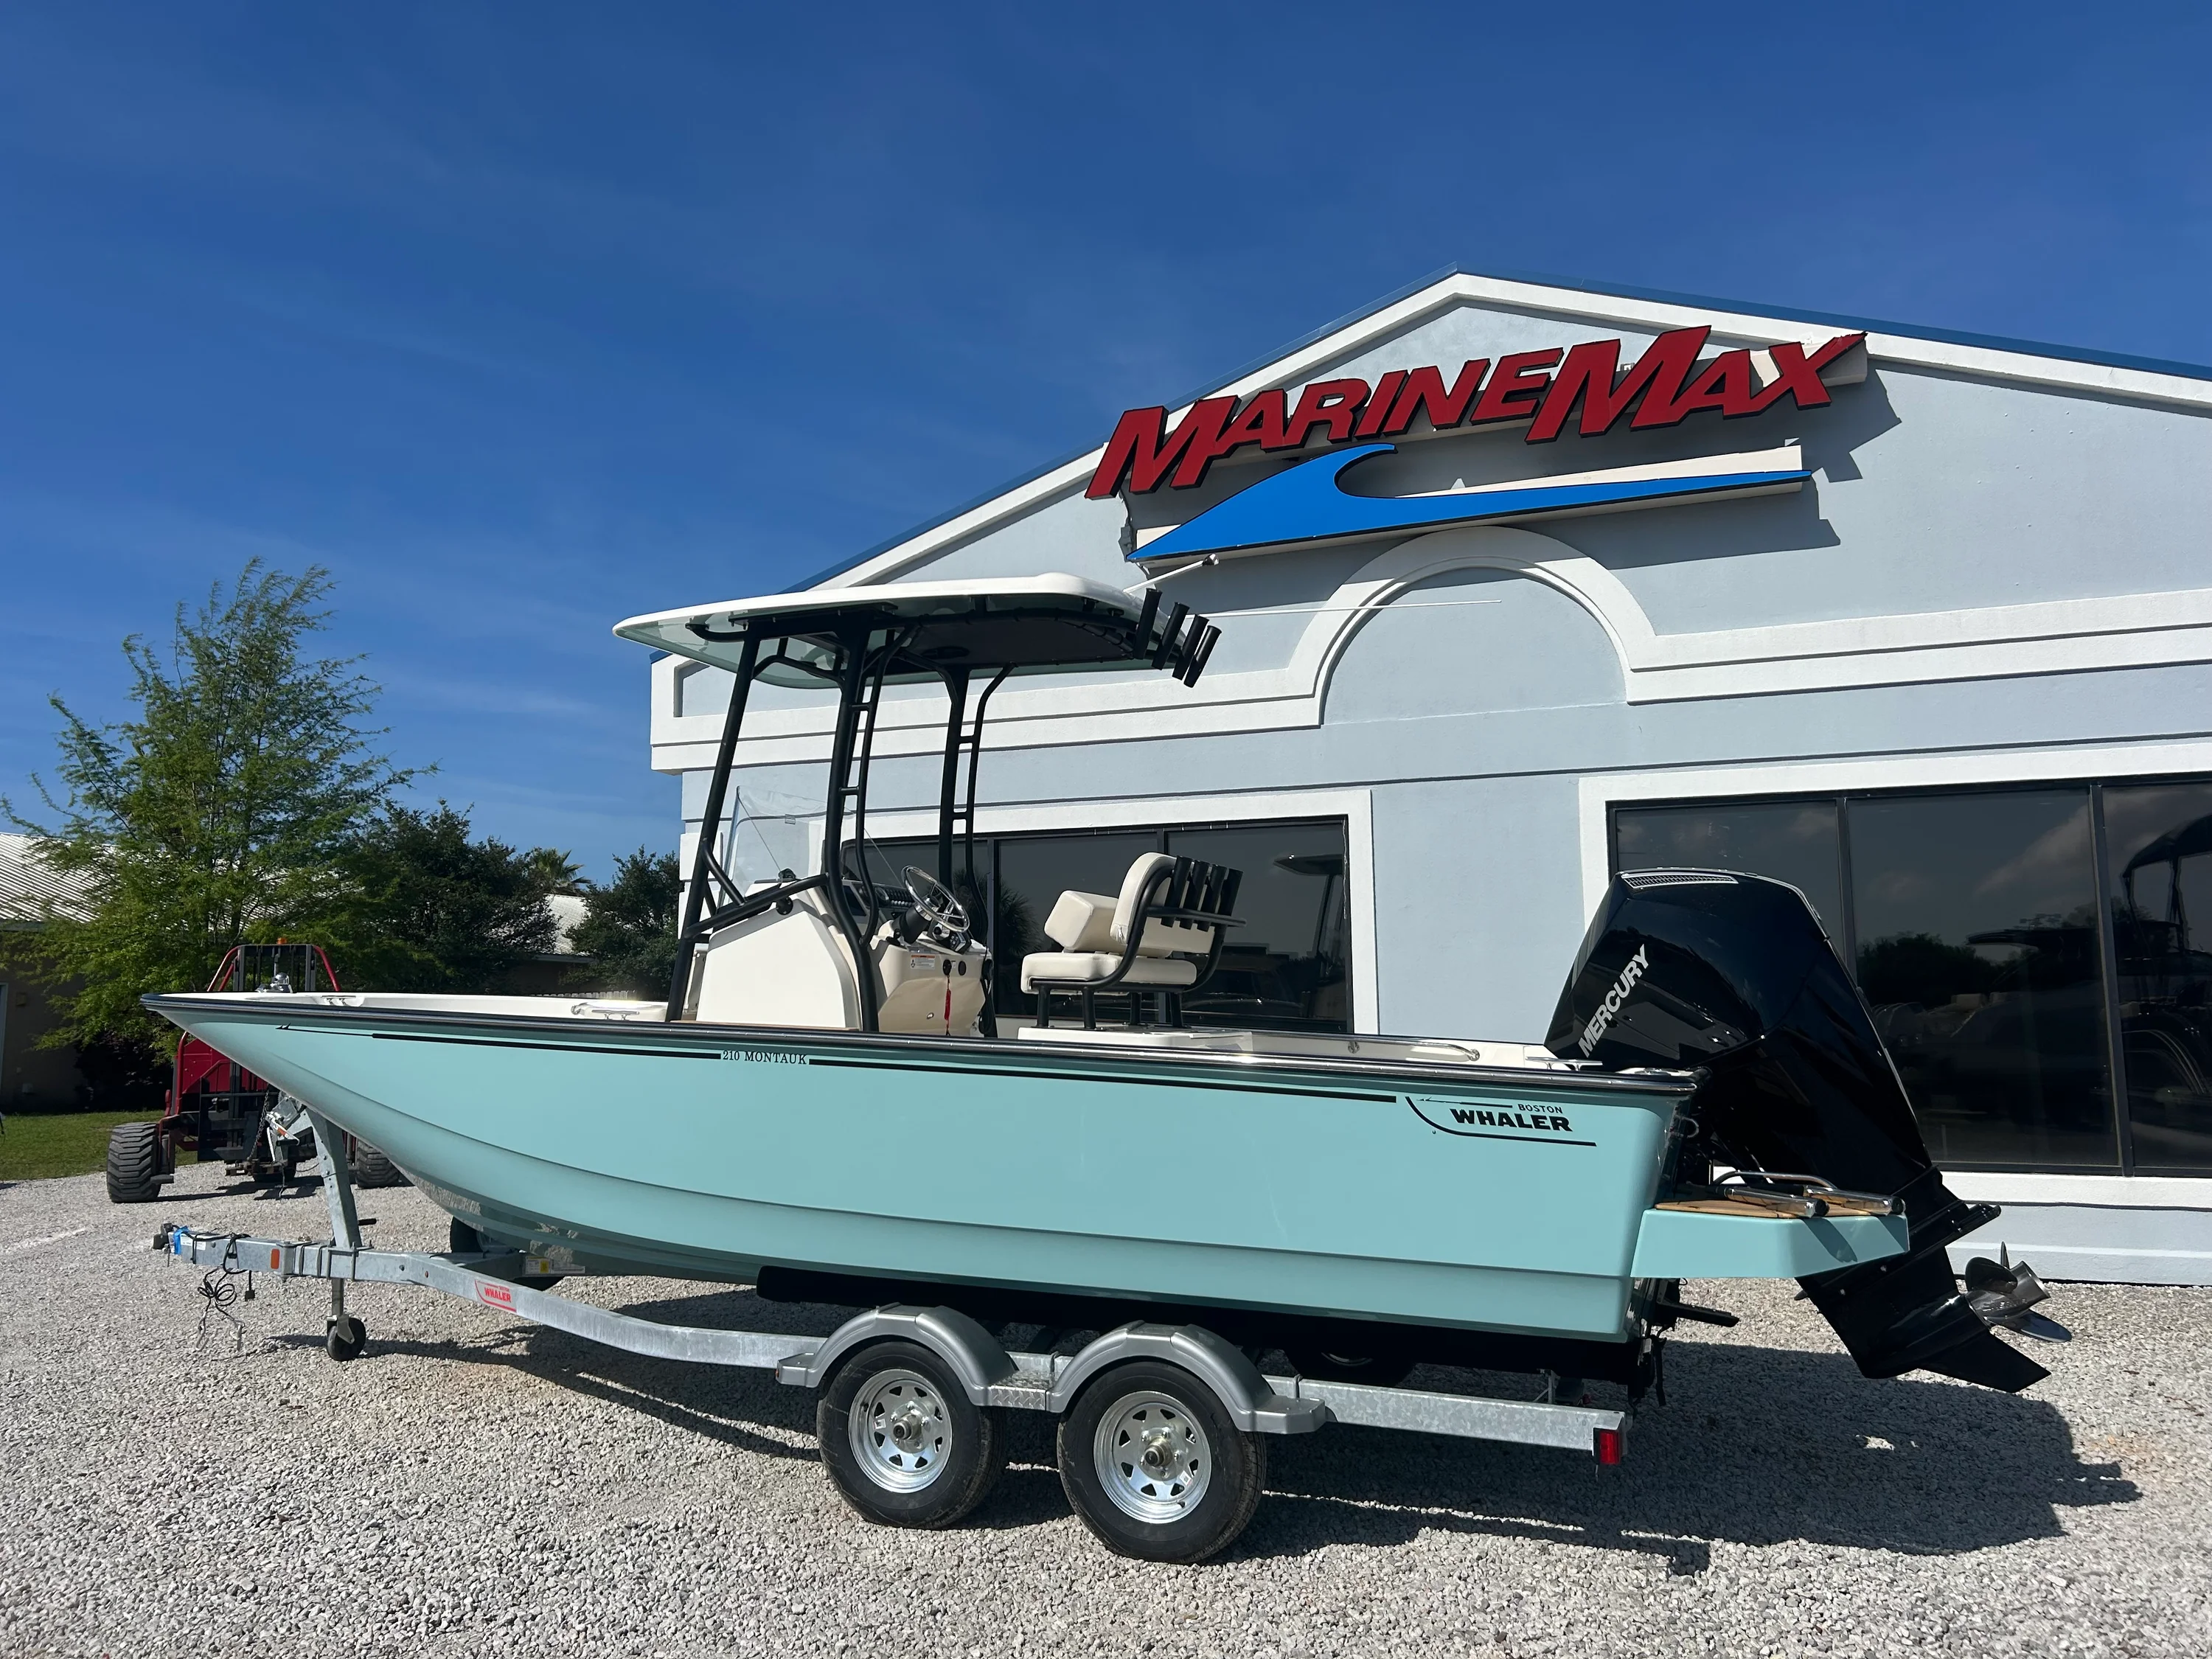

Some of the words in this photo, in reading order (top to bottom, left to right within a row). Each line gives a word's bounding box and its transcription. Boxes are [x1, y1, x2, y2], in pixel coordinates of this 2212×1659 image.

[1578, 944, 1649, 1057] MERCURY
[723, 1050, 740, 1060] 210
[744, 1051, 807, 1064] MONTAUK
[1518, 1103, 1563, 1114] BOSTON
[1450, 1108, 1573, 1132] WHALER
[484, 1287, 511, 1303] WHALER
